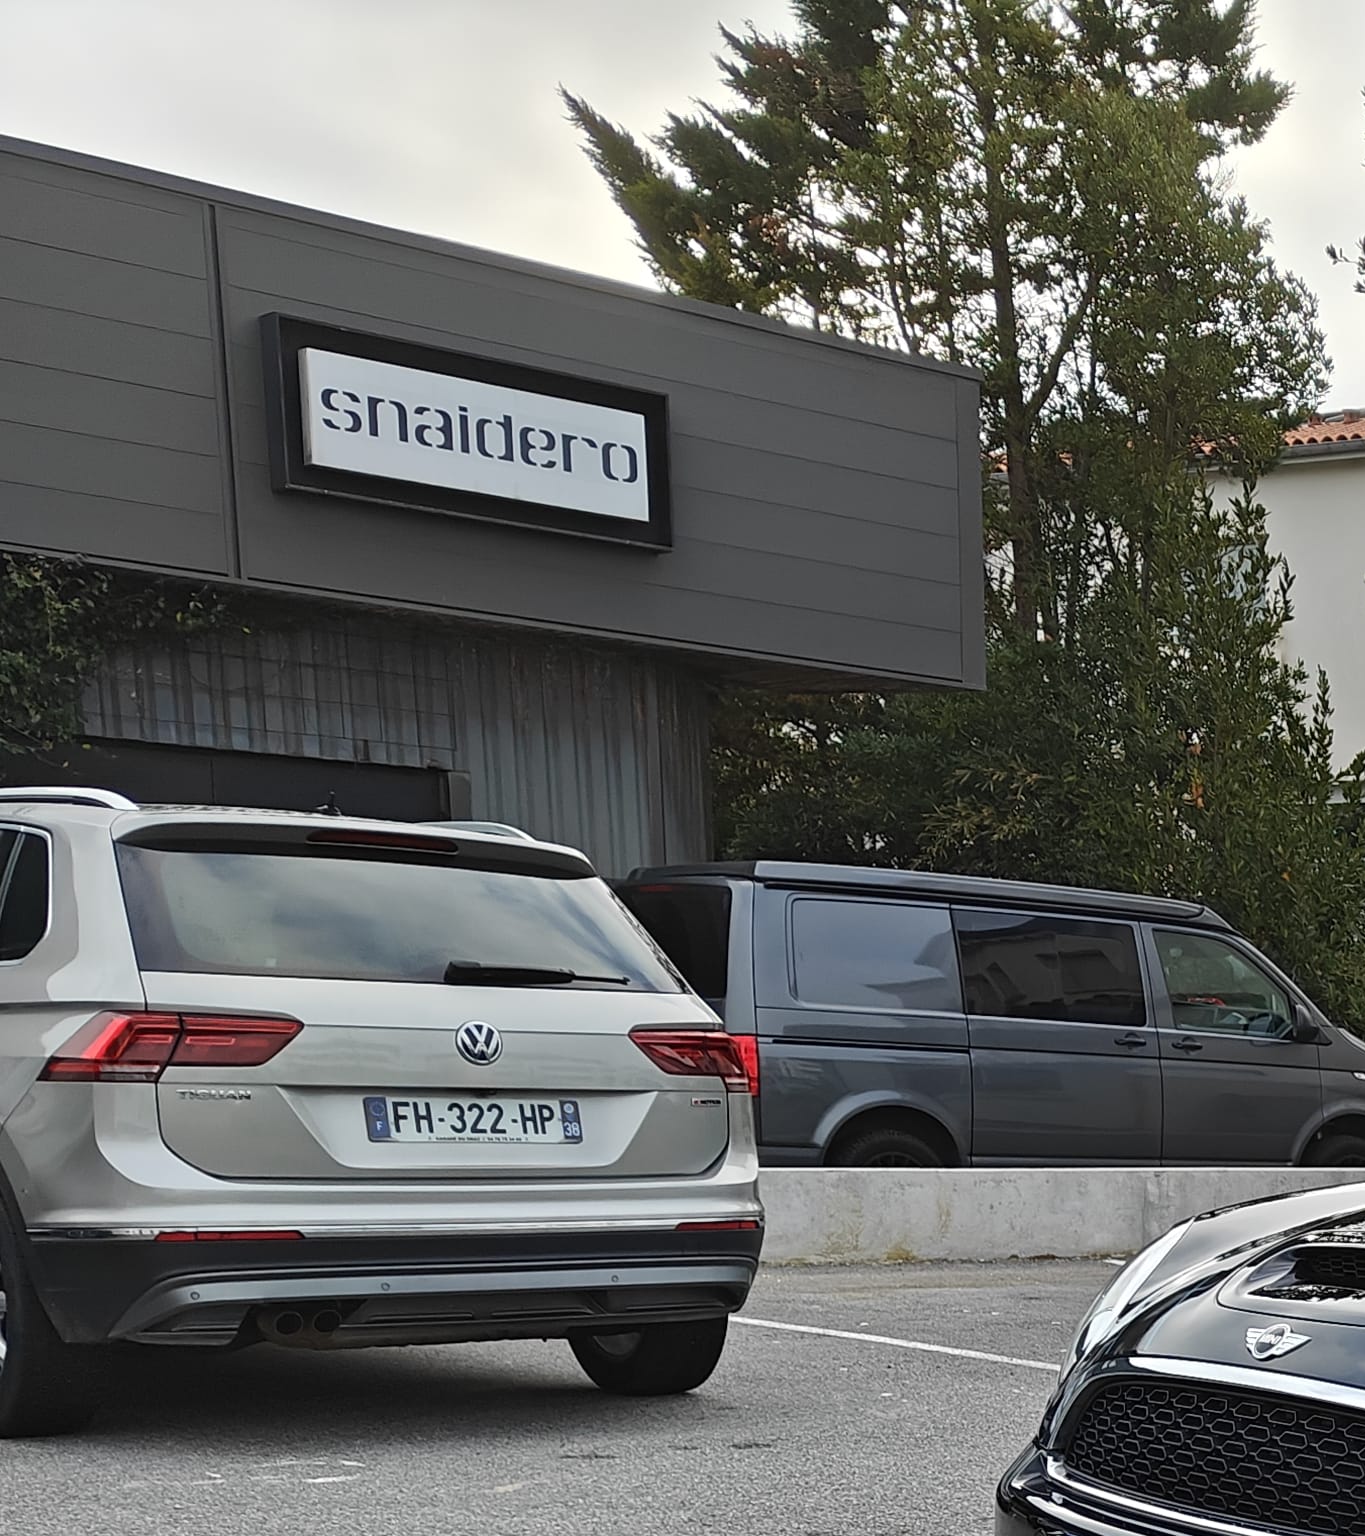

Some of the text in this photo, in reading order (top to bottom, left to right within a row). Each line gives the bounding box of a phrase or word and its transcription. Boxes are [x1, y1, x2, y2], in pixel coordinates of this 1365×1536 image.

[320, 387, 639, 484] snaidero
[176, 1089, 252, 1101] TIGUAN
[391, 1101, 555, 1135] FH-322-HP
[563, 1121, 580, 1137] 38
